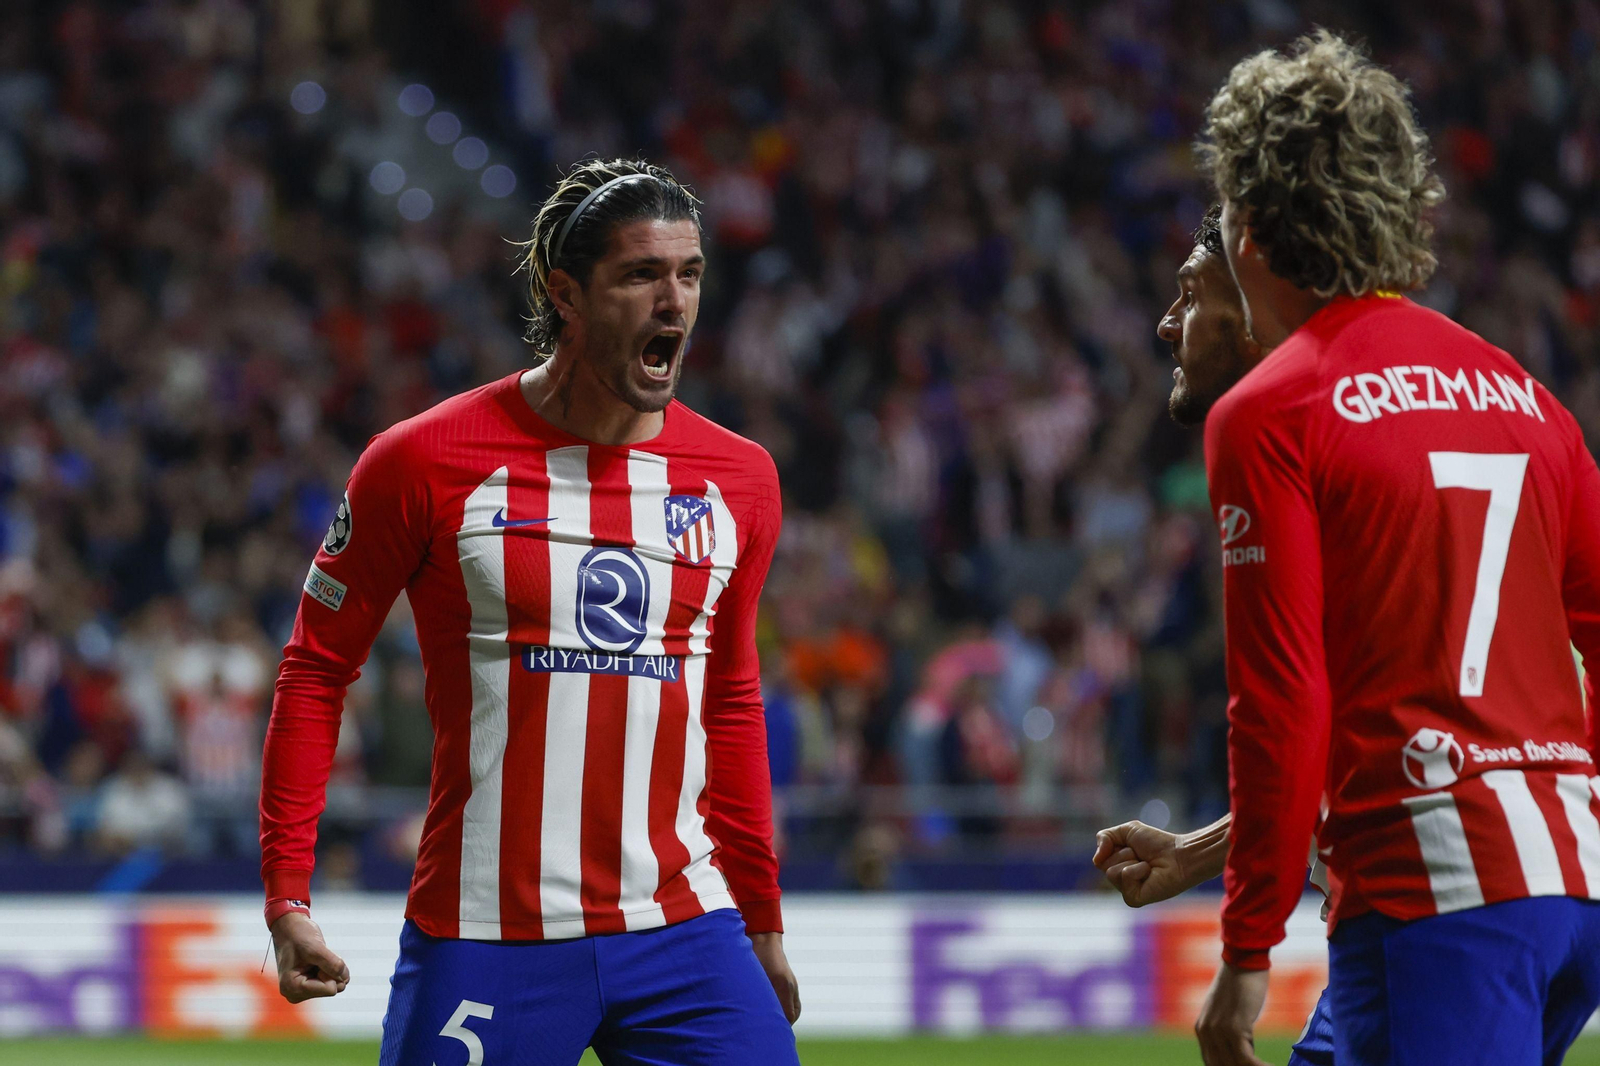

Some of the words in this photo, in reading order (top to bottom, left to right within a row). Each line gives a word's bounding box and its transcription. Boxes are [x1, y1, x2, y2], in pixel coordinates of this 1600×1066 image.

[1333, 365, 1546, 423] GRIEZMANN
[1222, 546, 1266, 567] NDAI
[1428, 451, 1531, 697] 7
[530, 645, 633, 672] RIYADH
[642, 655, 676, 679] AIR
[1468, 743, 1524, 763] Save
[432, 999, 495, 1066] 5
